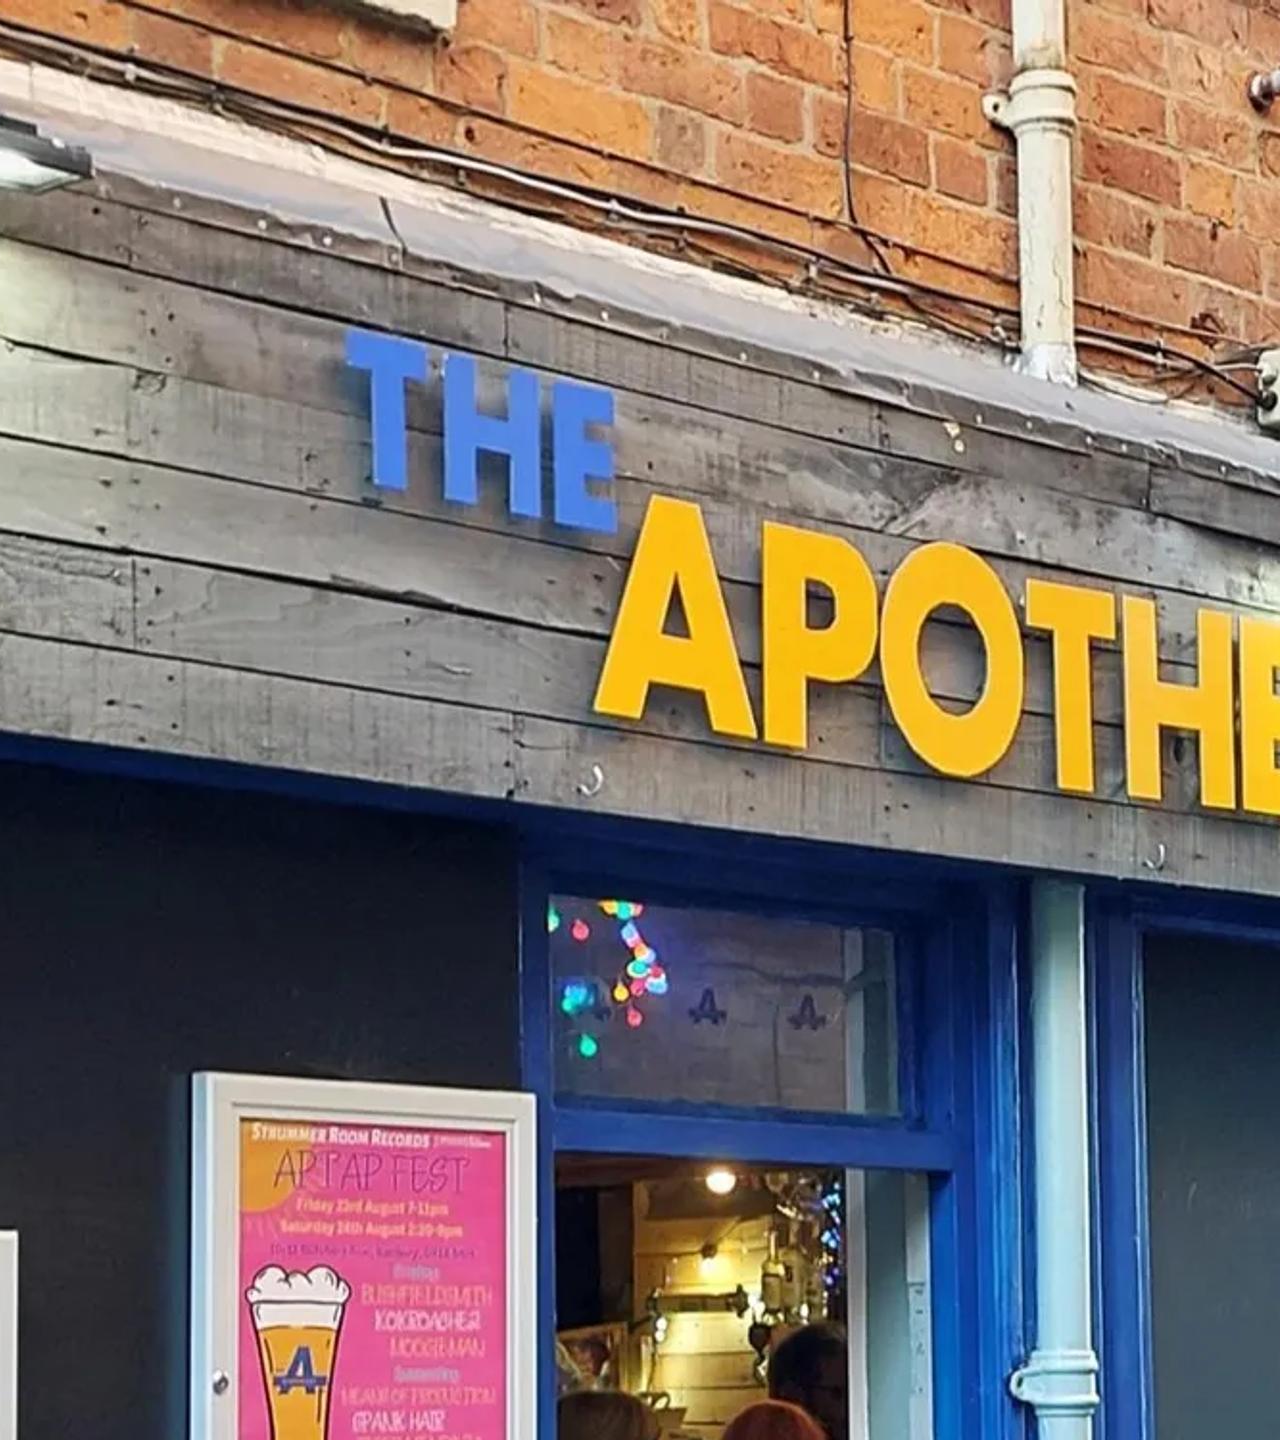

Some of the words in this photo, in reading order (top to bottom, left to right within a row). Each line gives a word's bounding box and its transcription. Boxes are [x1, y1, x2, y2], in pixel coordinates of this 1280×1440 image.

[345, 327, 616, 534] THE
[329, 1126, 370, 1146] ROOM
[372, 1129, 431, 1148] RECORDS
[391, 1154, 472, 1194] FEST
[296, 1197, 333, 1214] Friday
[365, 1199, 405, 1218] August
[280, 1219, 335, 1237] Saturday
[366, 1221, 405, 1239] August
